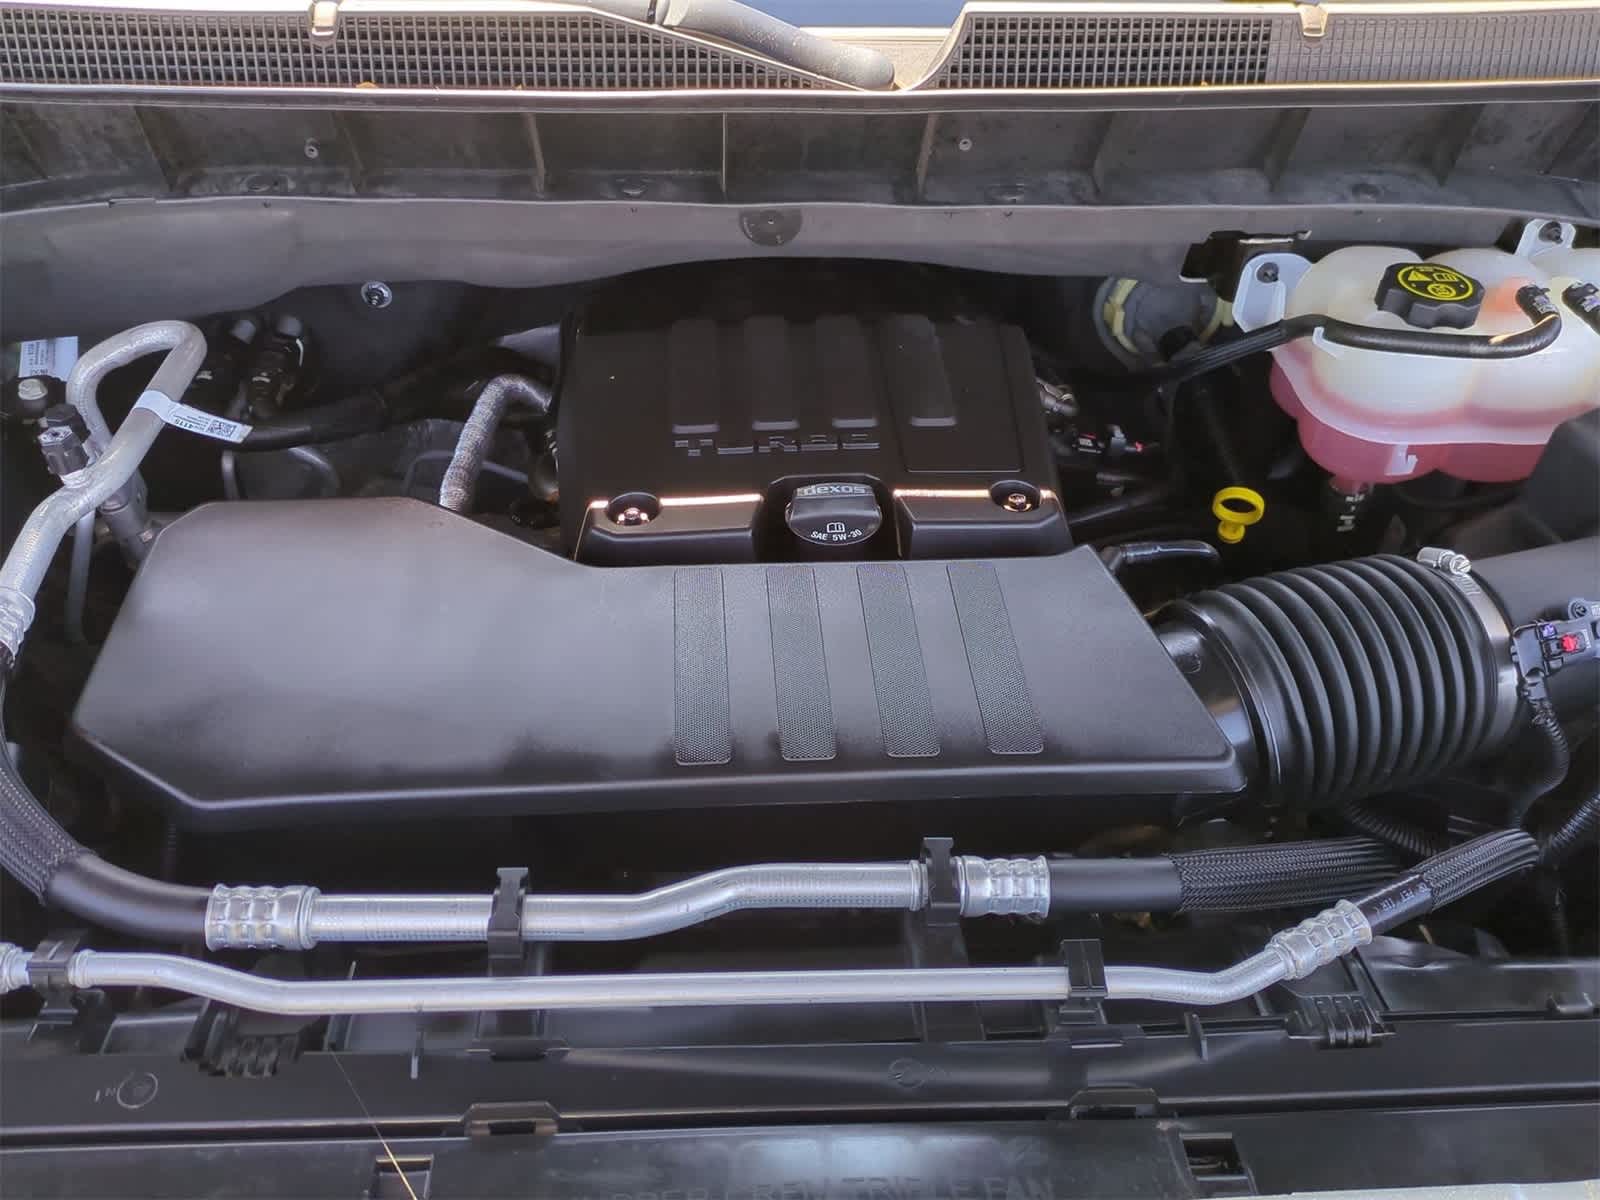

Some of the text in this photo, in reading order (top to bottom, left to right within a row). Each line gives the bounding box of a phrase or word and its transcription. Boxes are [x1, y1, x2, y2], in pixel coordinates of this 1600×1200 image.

[803, 484, 866, 496] dexos
[810, 528, 863, 541] SAE 5W-30
